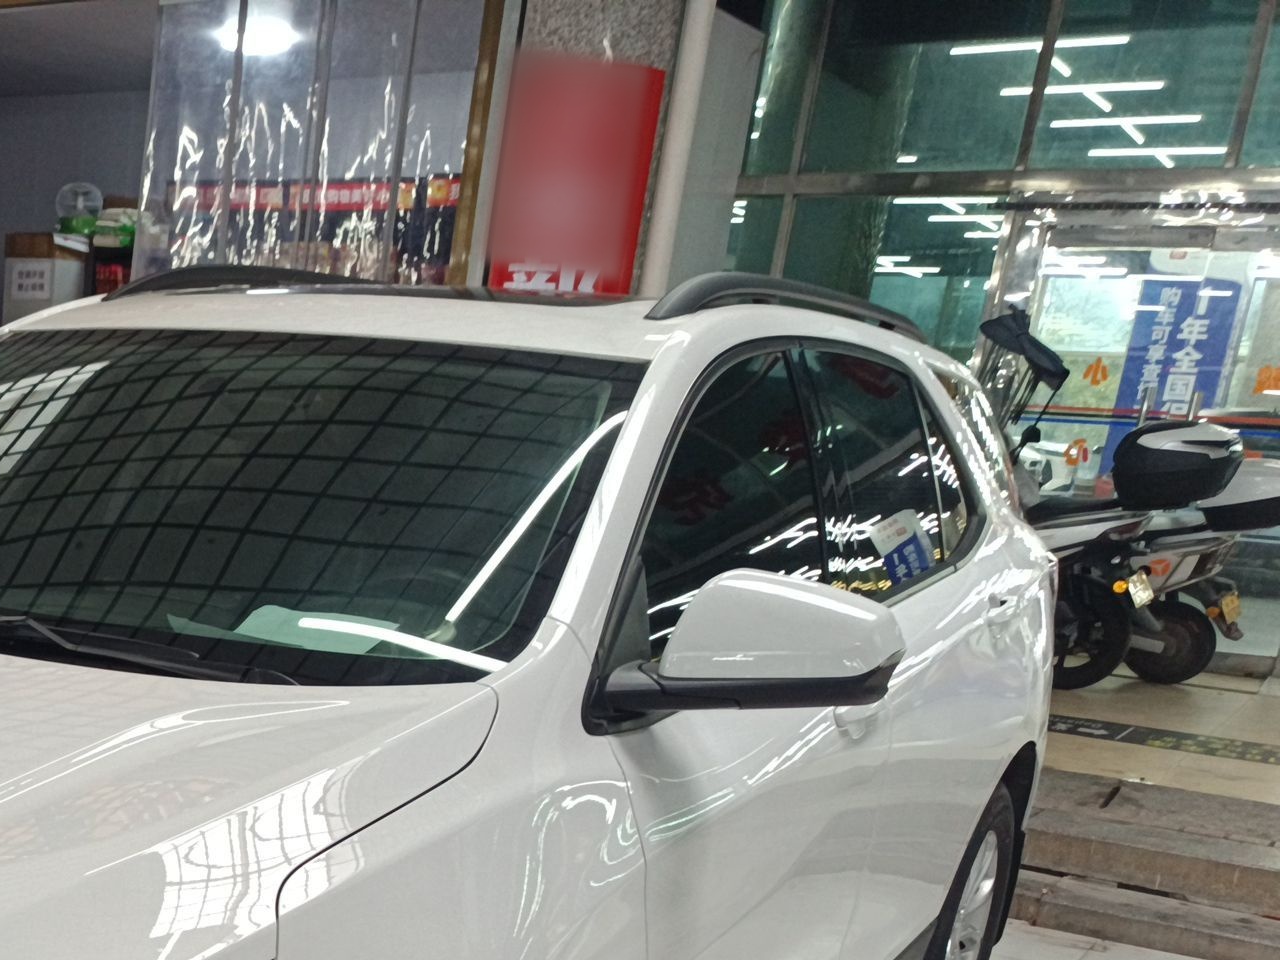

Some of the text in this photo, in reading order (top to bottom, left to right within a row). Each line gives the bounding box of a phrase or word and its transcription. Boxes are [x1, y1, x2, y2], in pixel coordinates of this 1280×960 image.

[1134, 286, 1182, 412] 购车可享查
